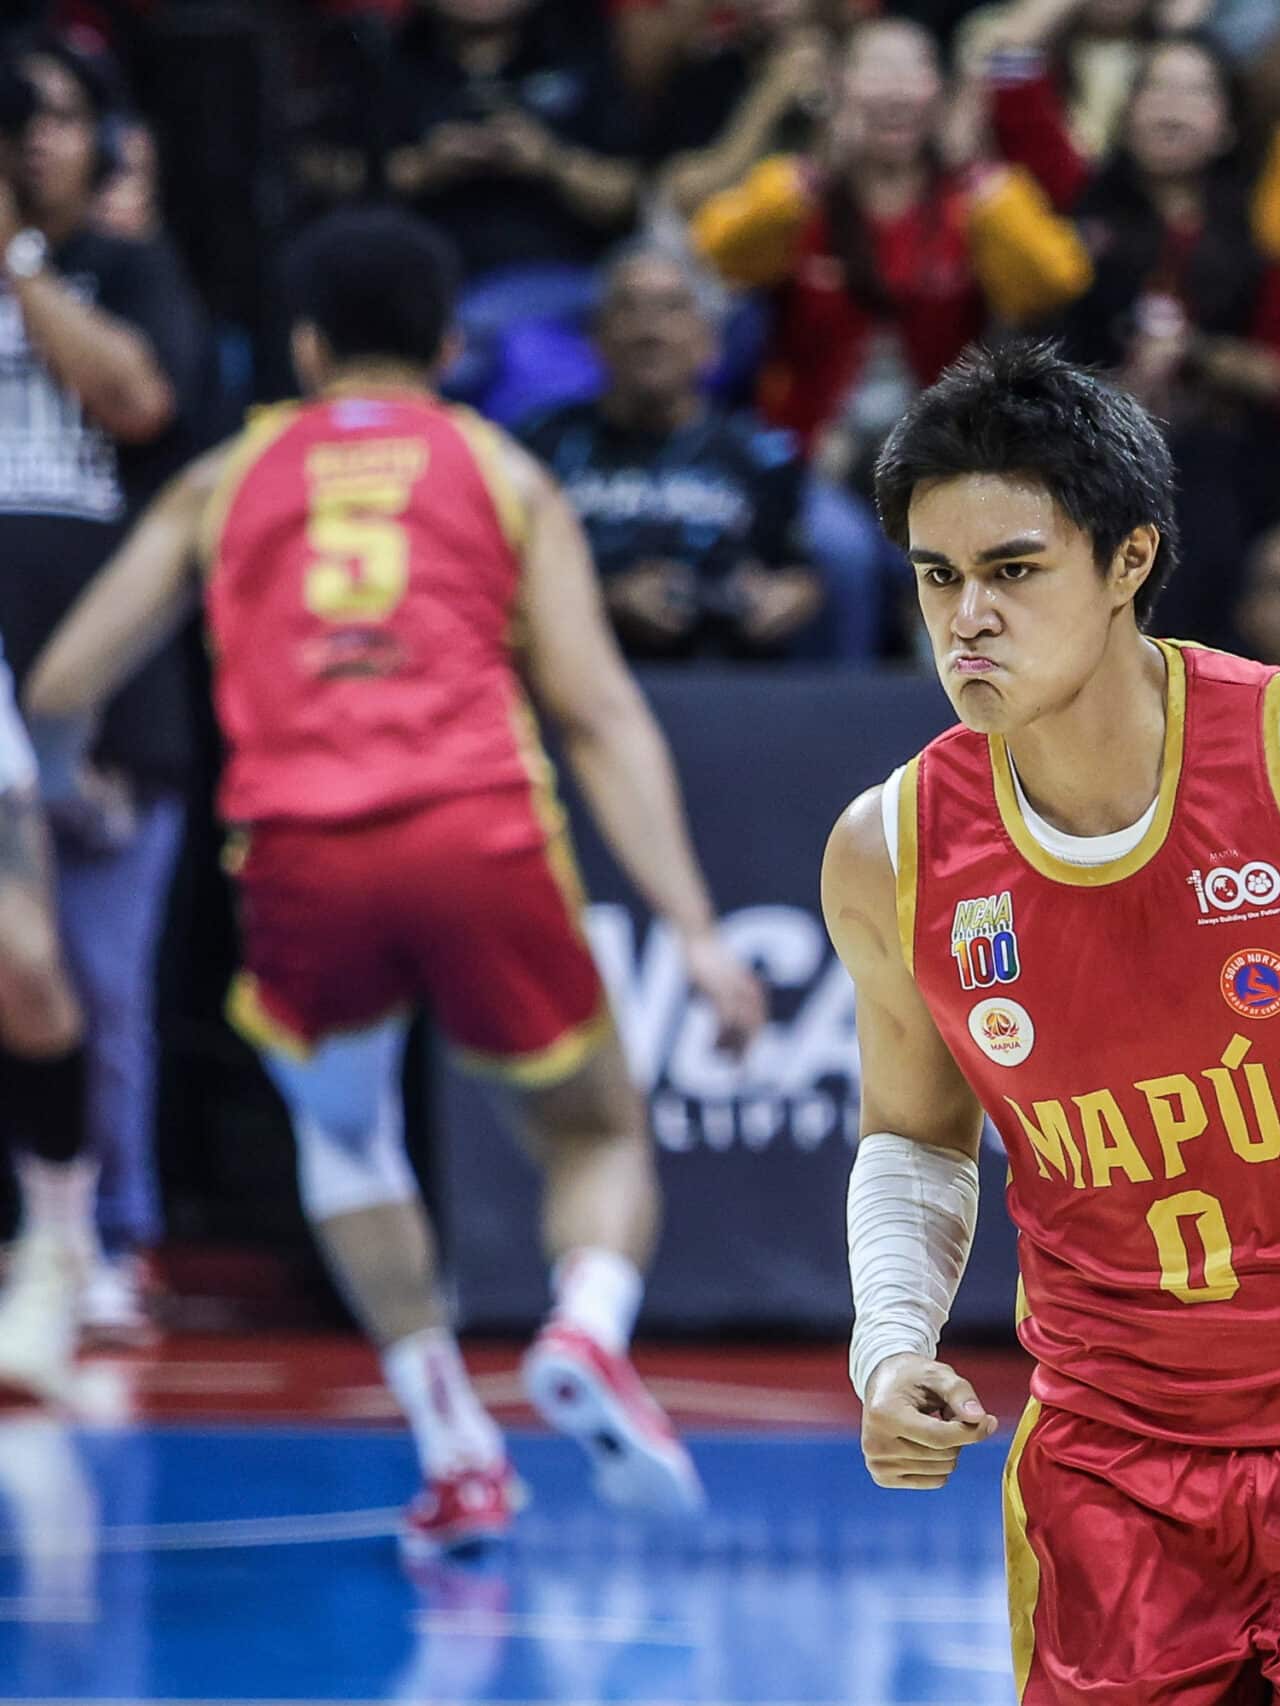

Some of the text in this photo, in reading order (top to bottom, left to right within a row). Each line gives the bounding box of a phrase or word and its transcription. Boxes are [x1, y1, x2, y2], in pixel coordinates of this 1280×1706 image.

[306, 485, 411, 623] 5
[955, 893, 1011, 930] NCAA
[955, 931, 1018, 987] 100
[1224, 956, 1246, 981] SOLID
[1145, 1189, 1241, 1304] 0
